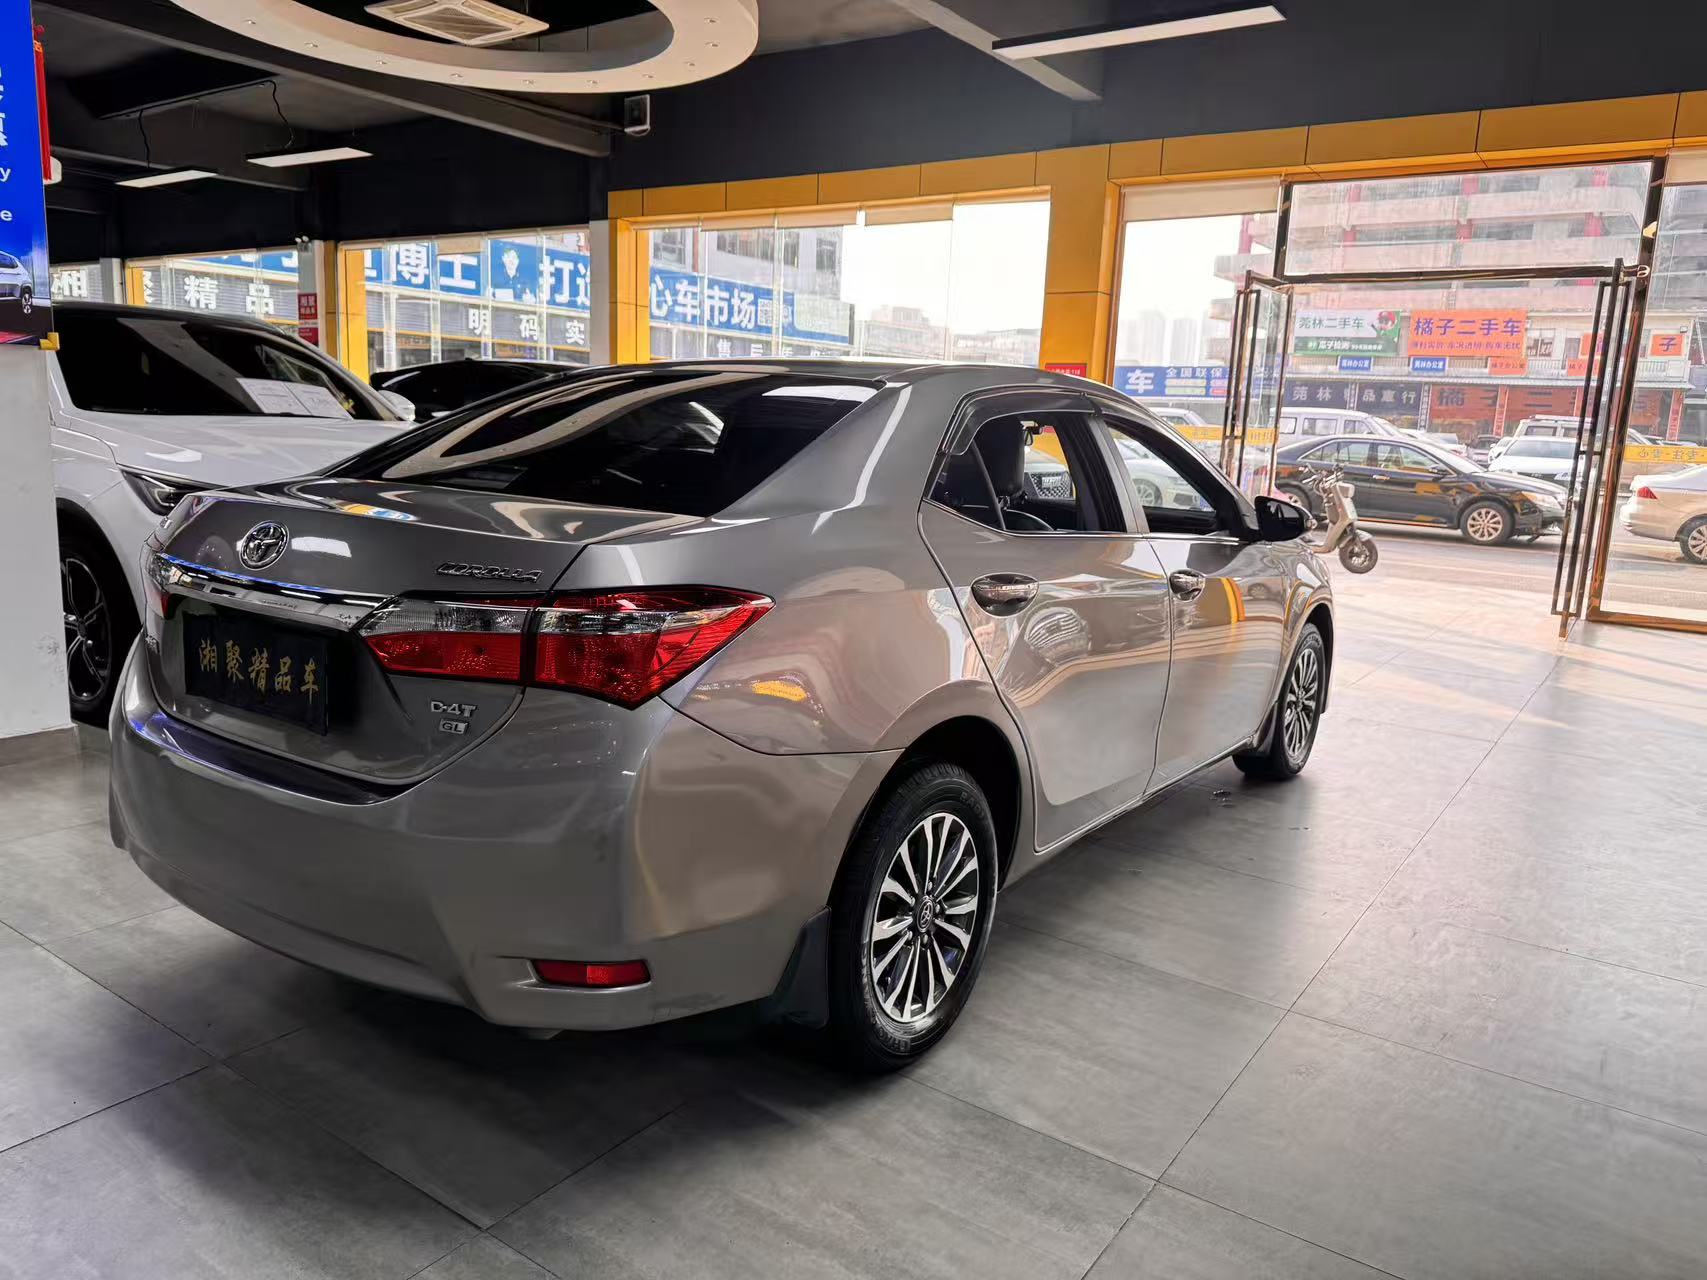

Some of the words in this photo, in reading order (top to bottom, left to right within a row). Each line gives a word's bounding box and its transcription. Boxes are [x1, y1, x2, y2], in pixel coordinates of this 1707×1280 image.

[650, 274, 756, 329] 心车市场
[1414, 318, 1521, 336] 橘子二手车
[1659, 337, 1677, 352] 子
[1126, 369, 1154, 393] 车
[437, 561, 542, 583] COROLLA
[431, 701, 476, 717] D-4T
[441, 720, 466, 734] GL
